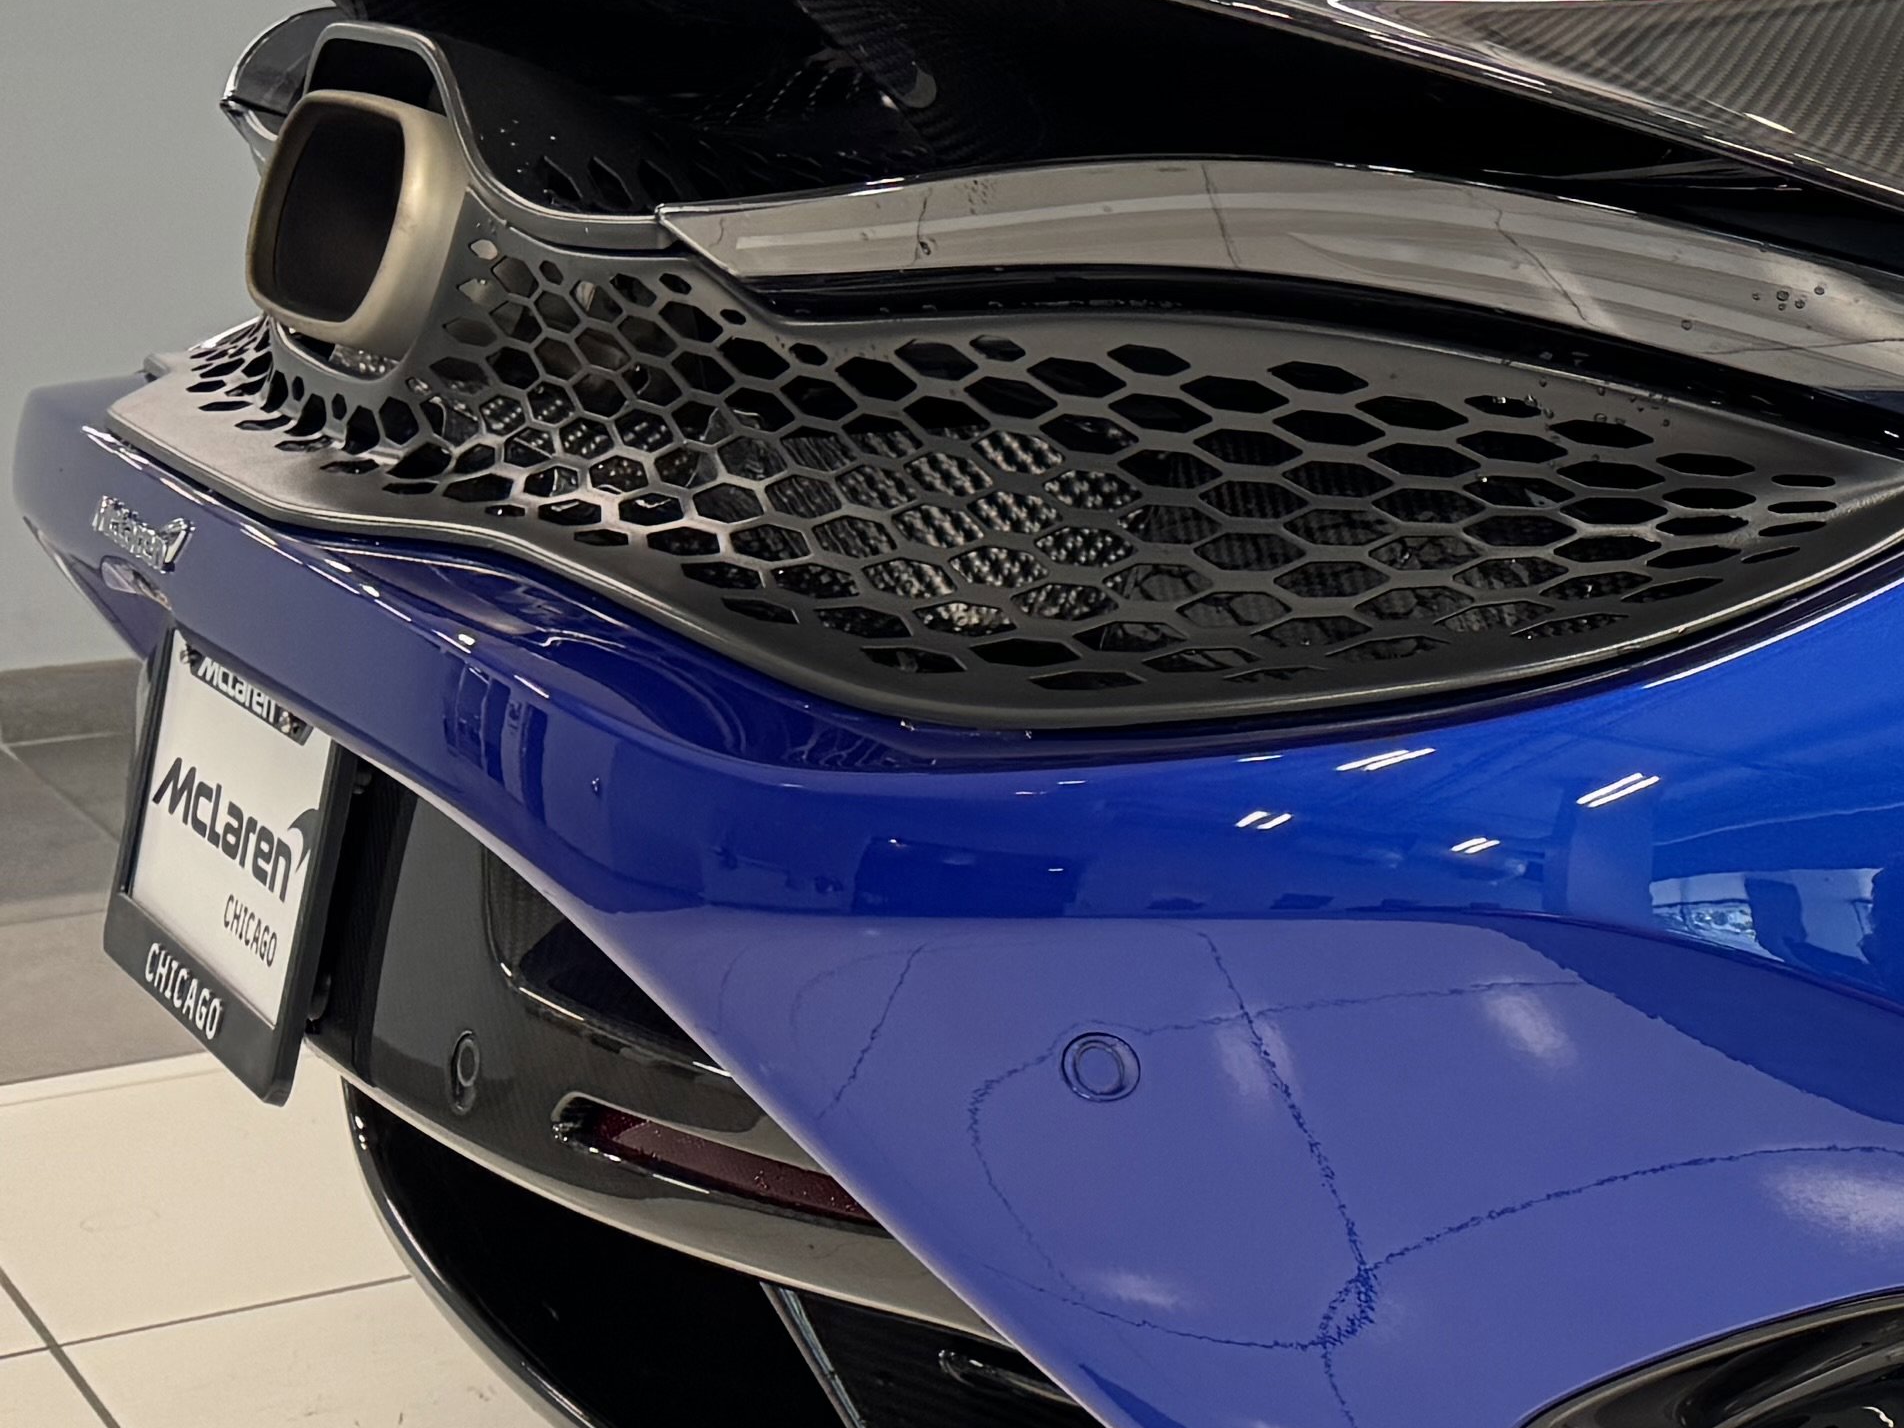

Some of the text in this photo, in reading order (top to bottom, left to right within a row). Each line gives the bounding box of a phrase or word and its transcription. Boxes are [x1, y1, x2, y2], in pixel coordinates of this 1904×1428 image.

[151, 756, 293, 903] McLaren
[223, 892, 278, 969] CHICAGO
[144, 942, 223, 1041] CHICAGO
